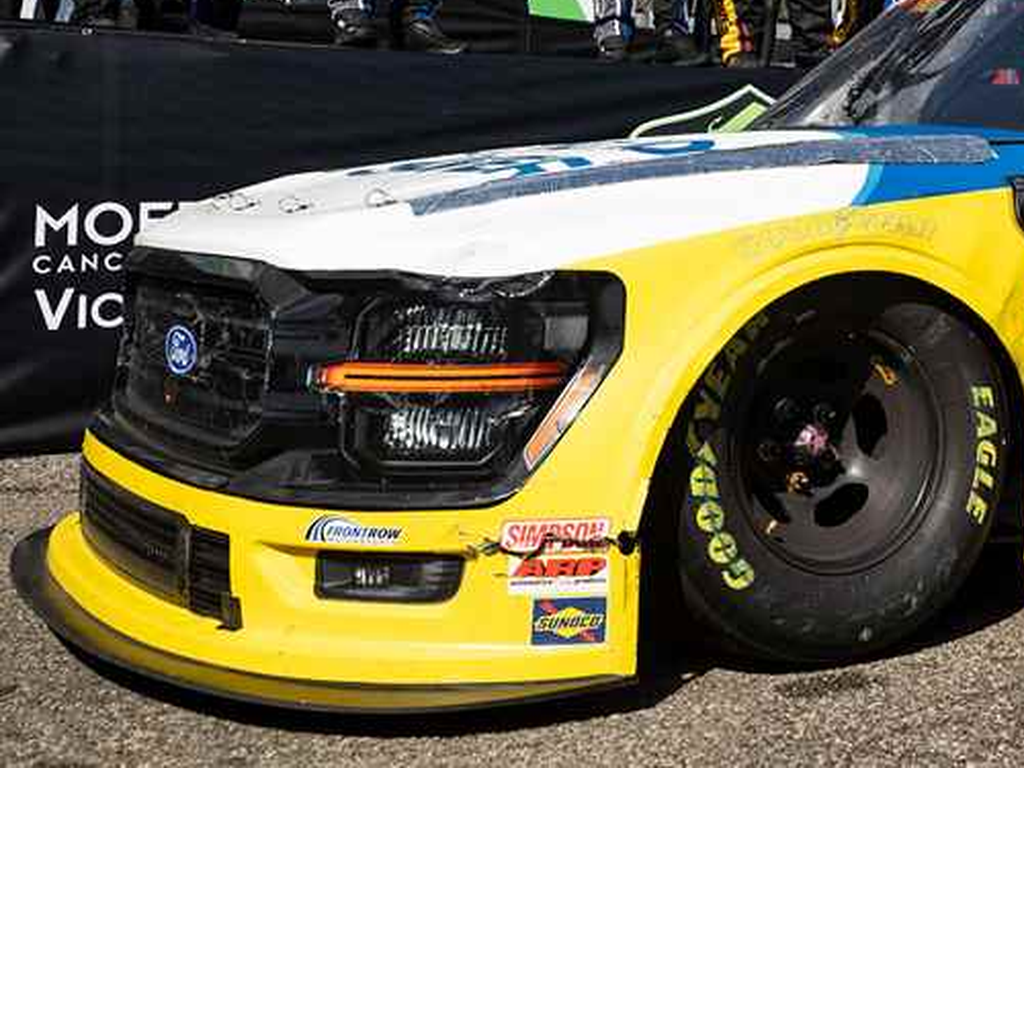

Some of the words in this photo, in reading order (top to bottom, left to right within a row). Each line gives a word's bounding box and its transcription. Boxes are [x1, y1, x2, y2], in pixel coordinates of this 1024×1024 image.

[35, 201, 174, 247] MOF
[32, 252, 124, 274] CANC
[34, 287, 125, 331] VIC
[965, 381, 998, 525] EAGLE
[535, 613, 605, 632] SUNOCO
